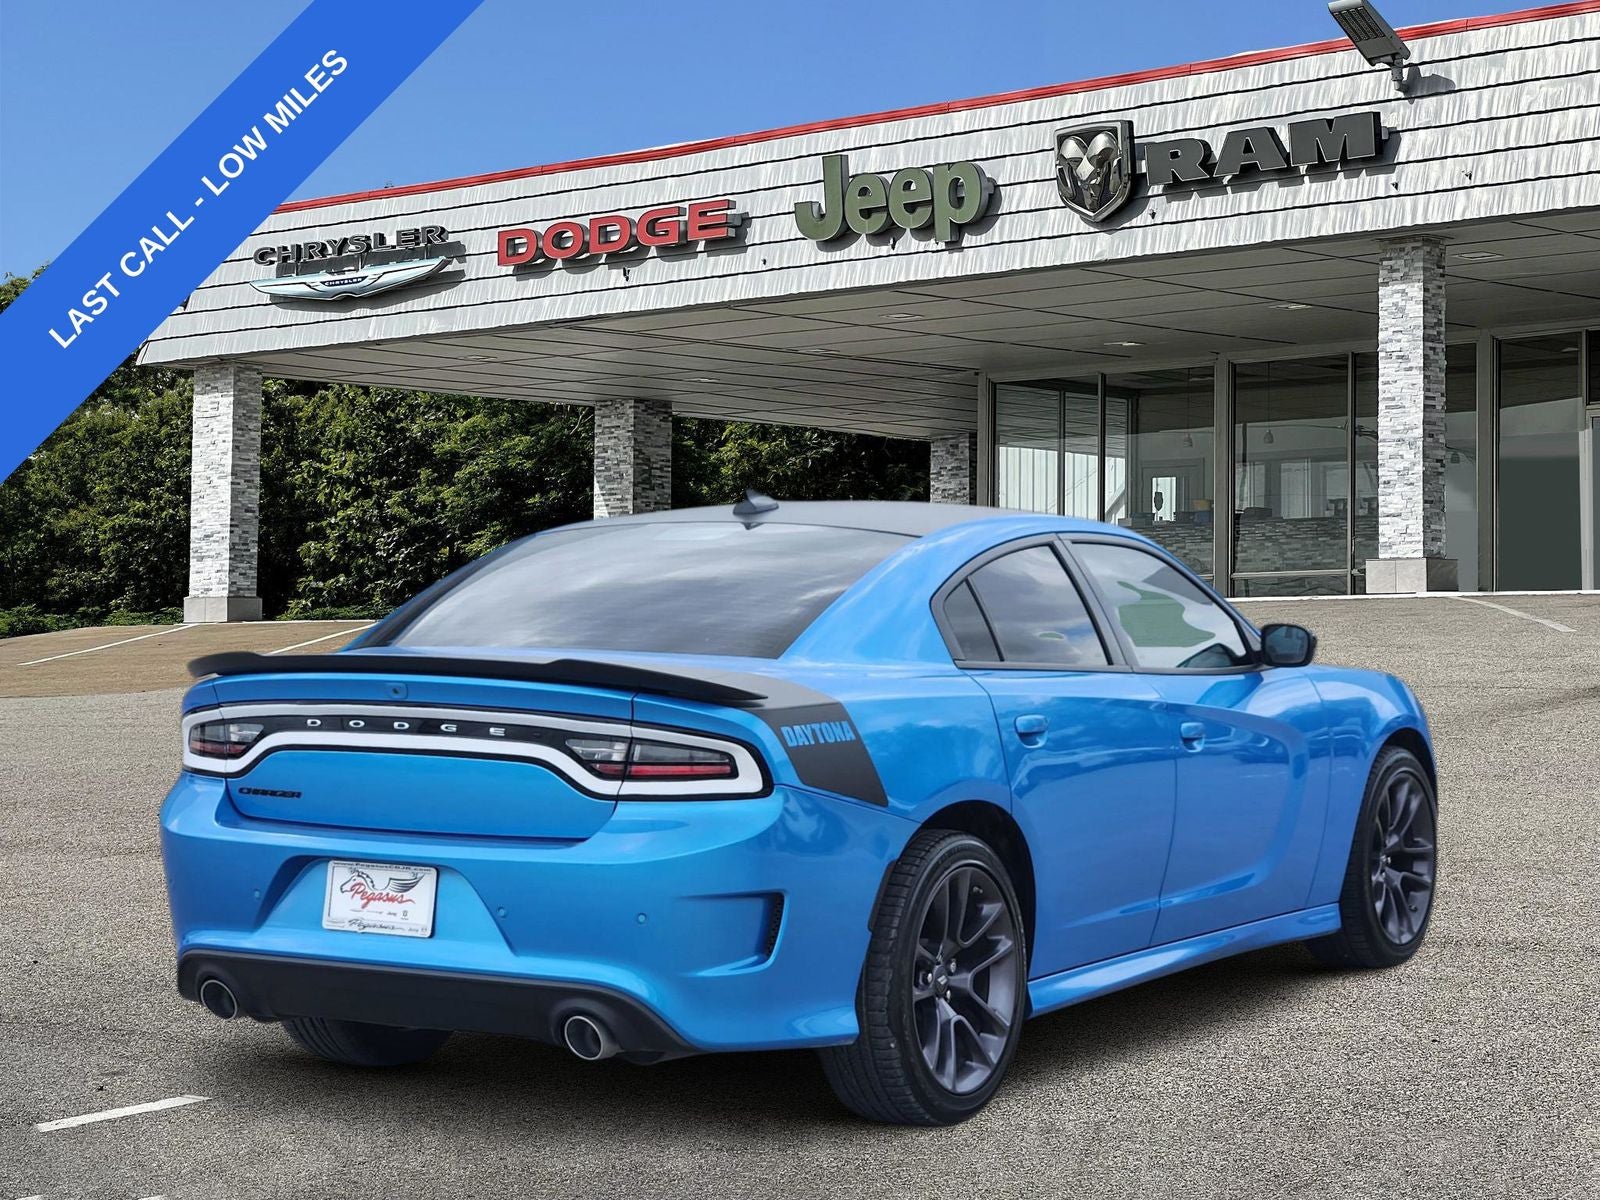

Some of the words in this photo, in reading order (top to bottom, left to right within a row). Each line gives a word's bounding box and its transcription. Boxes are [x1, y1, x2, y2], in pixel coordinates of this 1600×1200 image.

[1145, 111, 1388, 188] RAM
[794, 155, 996, 244] Jeep
[253, 225, 449, 266] CHRYSLER
[497, 199, 737, 267] DODGE
[324, 278, 363, 286] CHRYSLER
[306, 718, 506, 737] DODGE
[780, 721, 856, 747] DAYTONA
[350, 882, 416, 909] Pegasus
